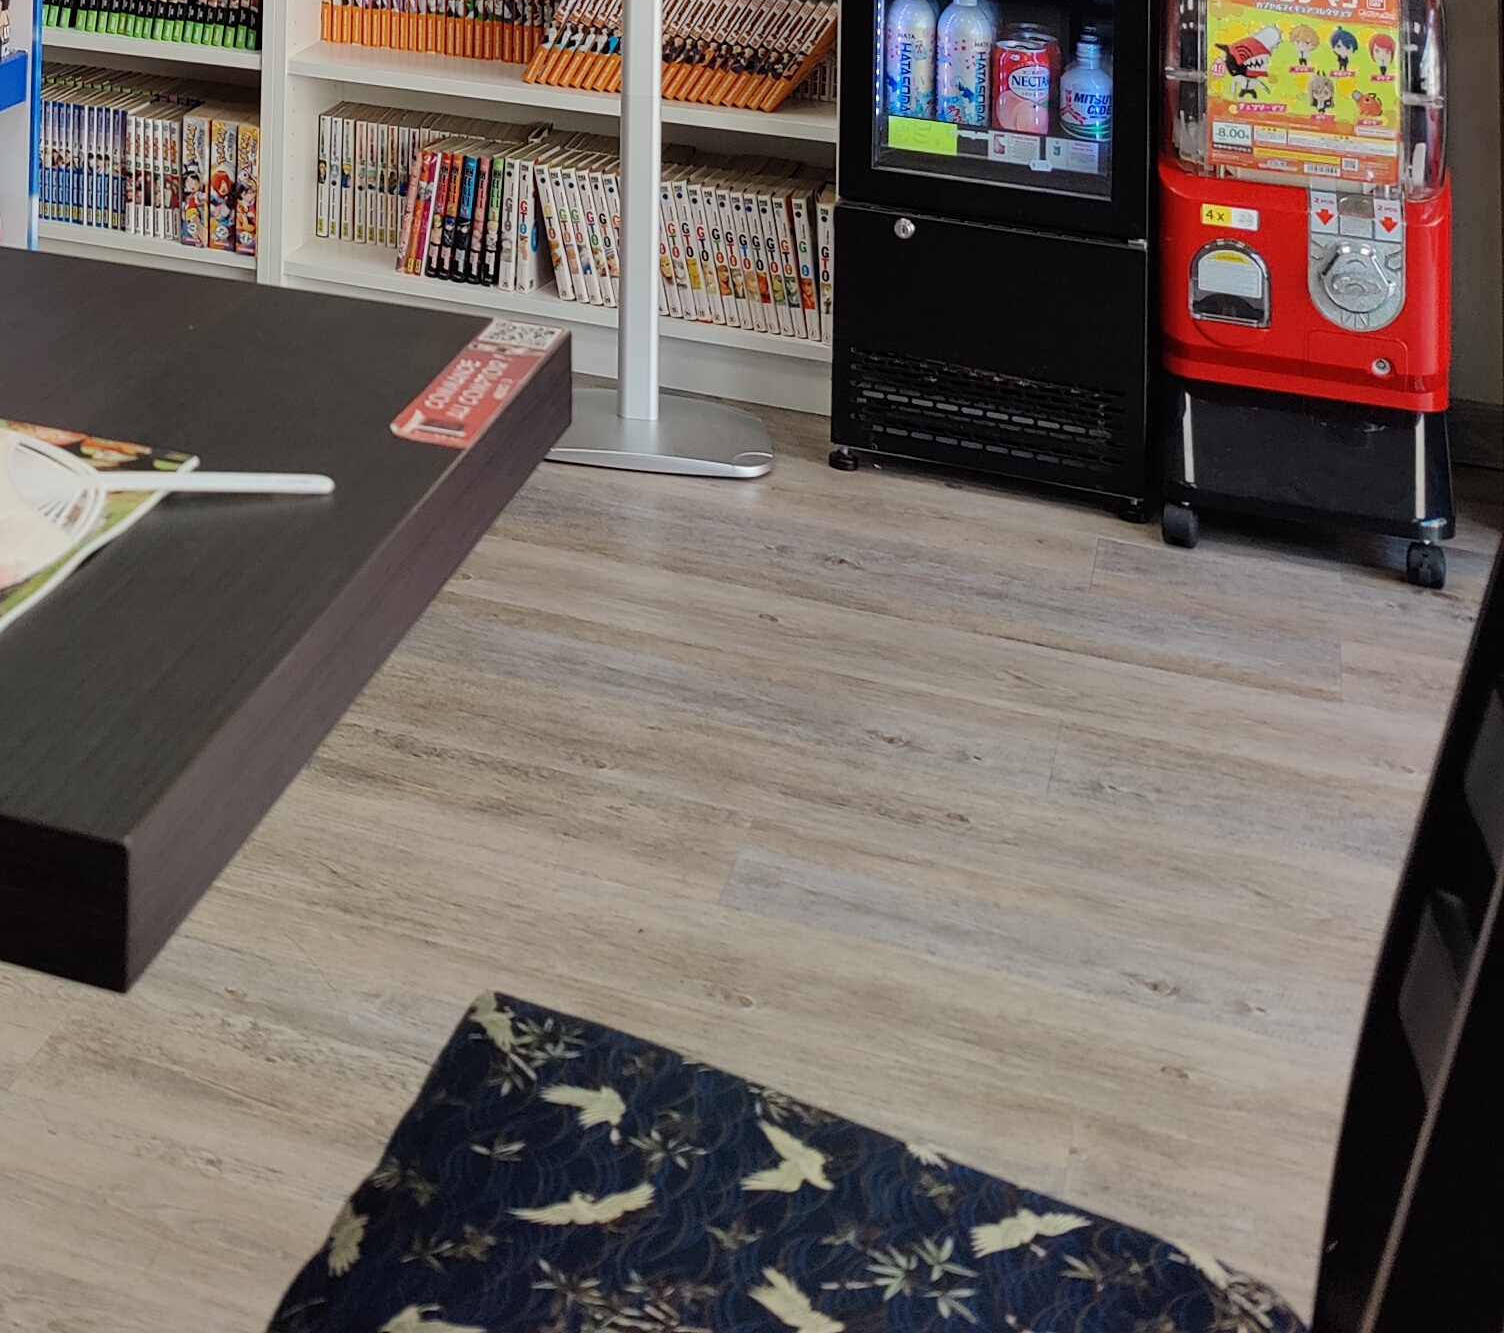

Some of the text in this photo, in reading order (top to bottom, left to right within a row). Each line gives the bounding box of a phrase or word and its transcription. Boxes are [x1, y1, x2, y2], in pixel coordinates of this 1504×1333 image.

[1010, 75, 1050, 88] NECTA
[520, 200, 528, 235] GTO
[696, 226, 709, 262] GTO
[739, 234, 751, 270] GTO
[820, 246, 830, 283] GTO
